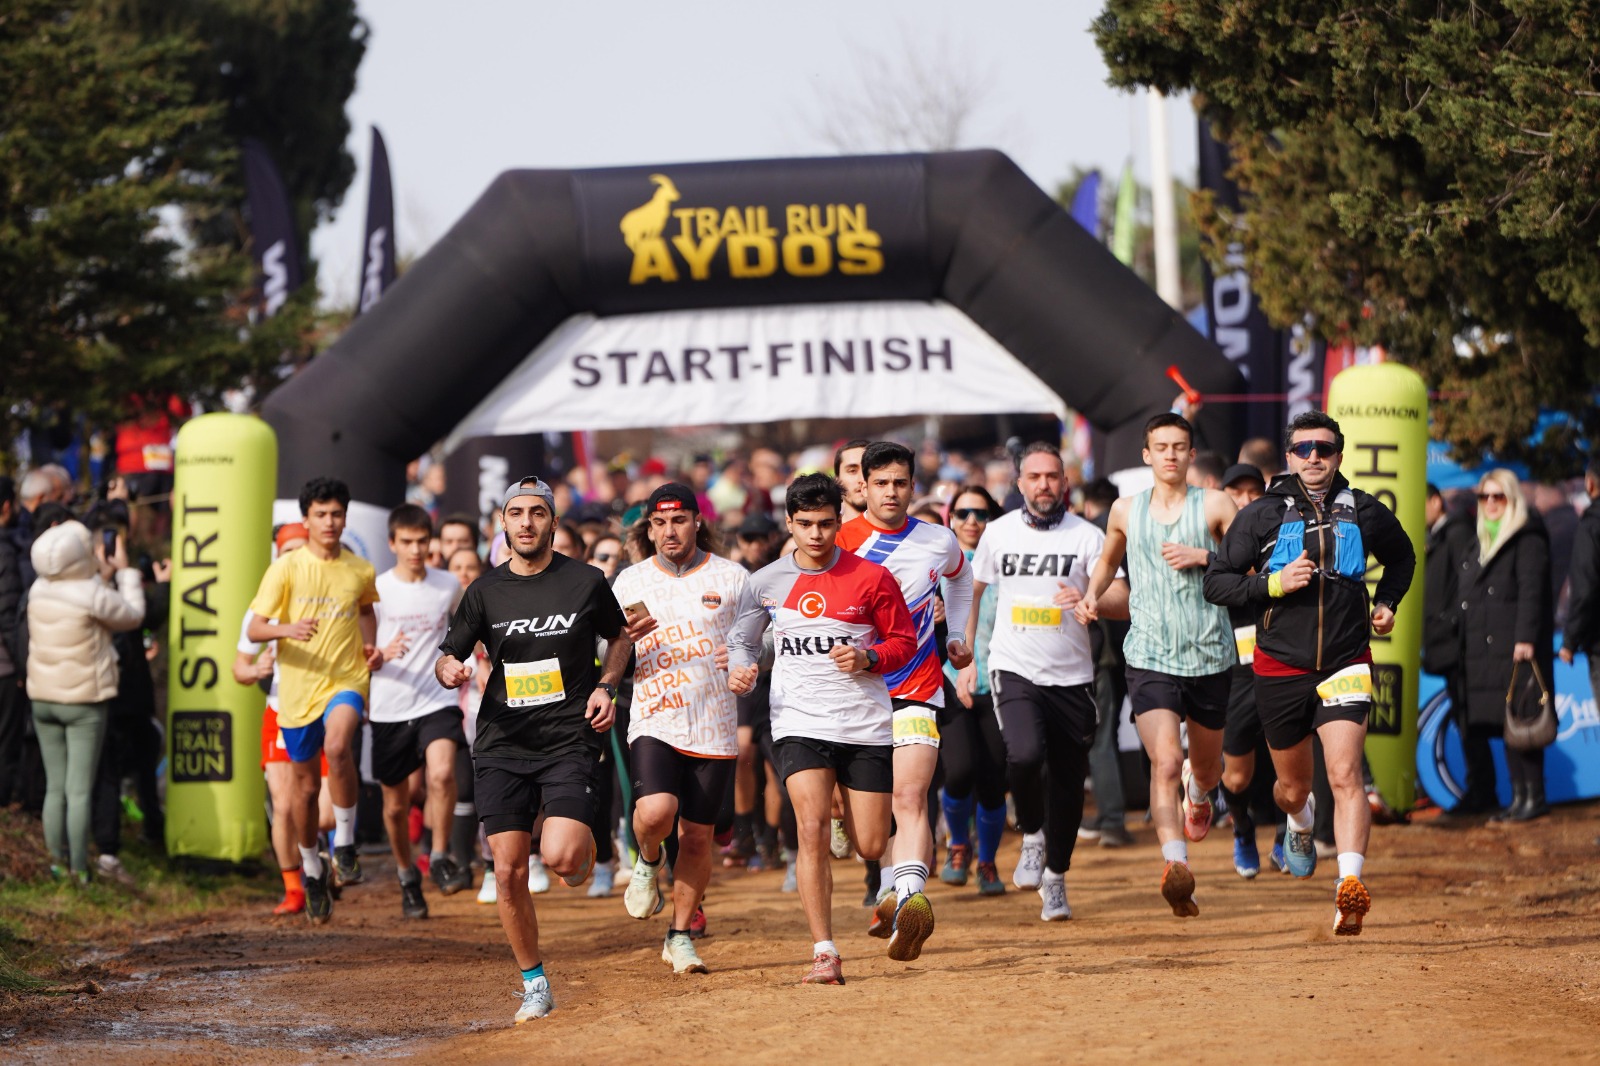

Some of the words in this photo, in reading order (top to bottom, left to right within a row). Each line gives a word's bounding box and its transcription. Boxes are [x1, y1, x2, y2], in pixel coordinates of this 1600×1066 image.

[672, 206, 778, 239] TRAIL
[786, 203, 868, 237] RUN
[629, 230, 884, 285] AYDOS
[571, 337, 953, 388] START-FINISH
[1335, 404, 1419, 419] SALOMON
[1001, 553, 1077, 577] BEAT
[179, 493, 219, 691] START
[505, 612, 577, 637] RUN
[1020, 609, 1051, 624] 106
[634, 638, 714, 683] BELGRAD
[514, 674, 553, 696] 205
[635, 669, 692, 704] ULTRA
[1331, 676, 1364, 694] 104
[640, 691, 691, 719] TRAIL
[205, 717, 226, 732] TO
[898, 718, 930, 734] 218
[175, 732, 224, 752] TRAIL
[174, 753, 225, 776] RUN
